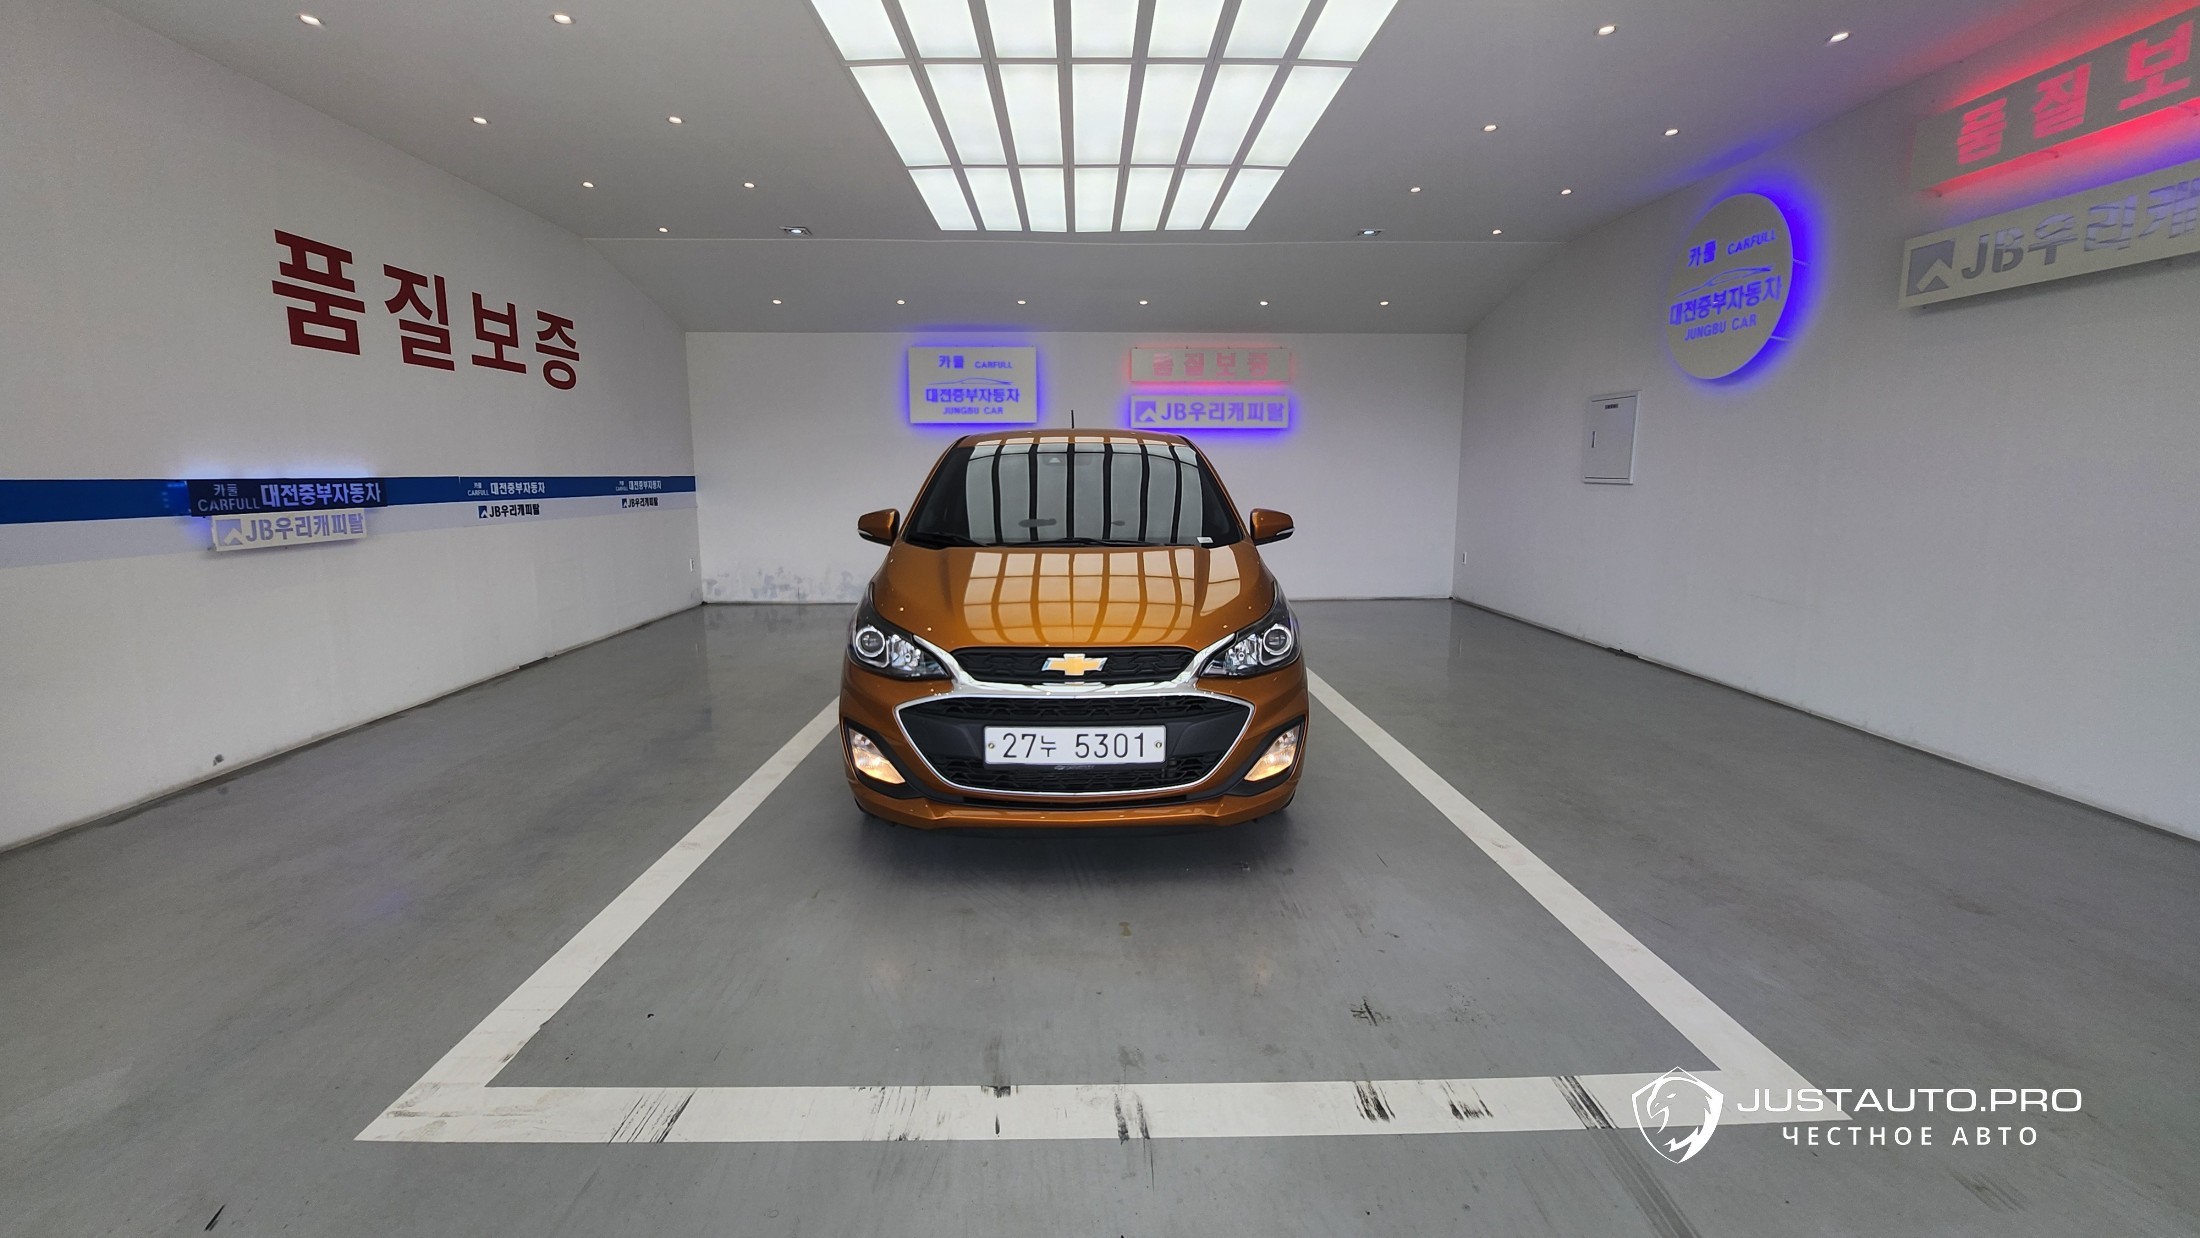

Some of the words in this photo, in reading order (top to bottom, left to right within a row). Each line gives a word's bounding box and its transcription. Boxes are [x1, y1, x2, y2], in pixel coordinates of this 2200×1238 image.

[1727, 229, 1777, 256] CARFULL
[271, 228, 582, 391] 품질보증
[1684, 319, 1727, 341] JUNGBU
[1731, 313, 1758, 331] CAR
[974, 361, 1012, 369] CARFULL
[983, 407, 1004, 415] CAR
[1161, 402, 1285, 422] JB우리캐피탈
[197, 497, 261, 512] CARFULL
[260, 482, 381, 508] 대전중부자동차
[246, 513, 364, 542] JB우리캐피탈
[1002, 732, 1057, 758] 27누
[1075, 732, 1144, 758] 5301
